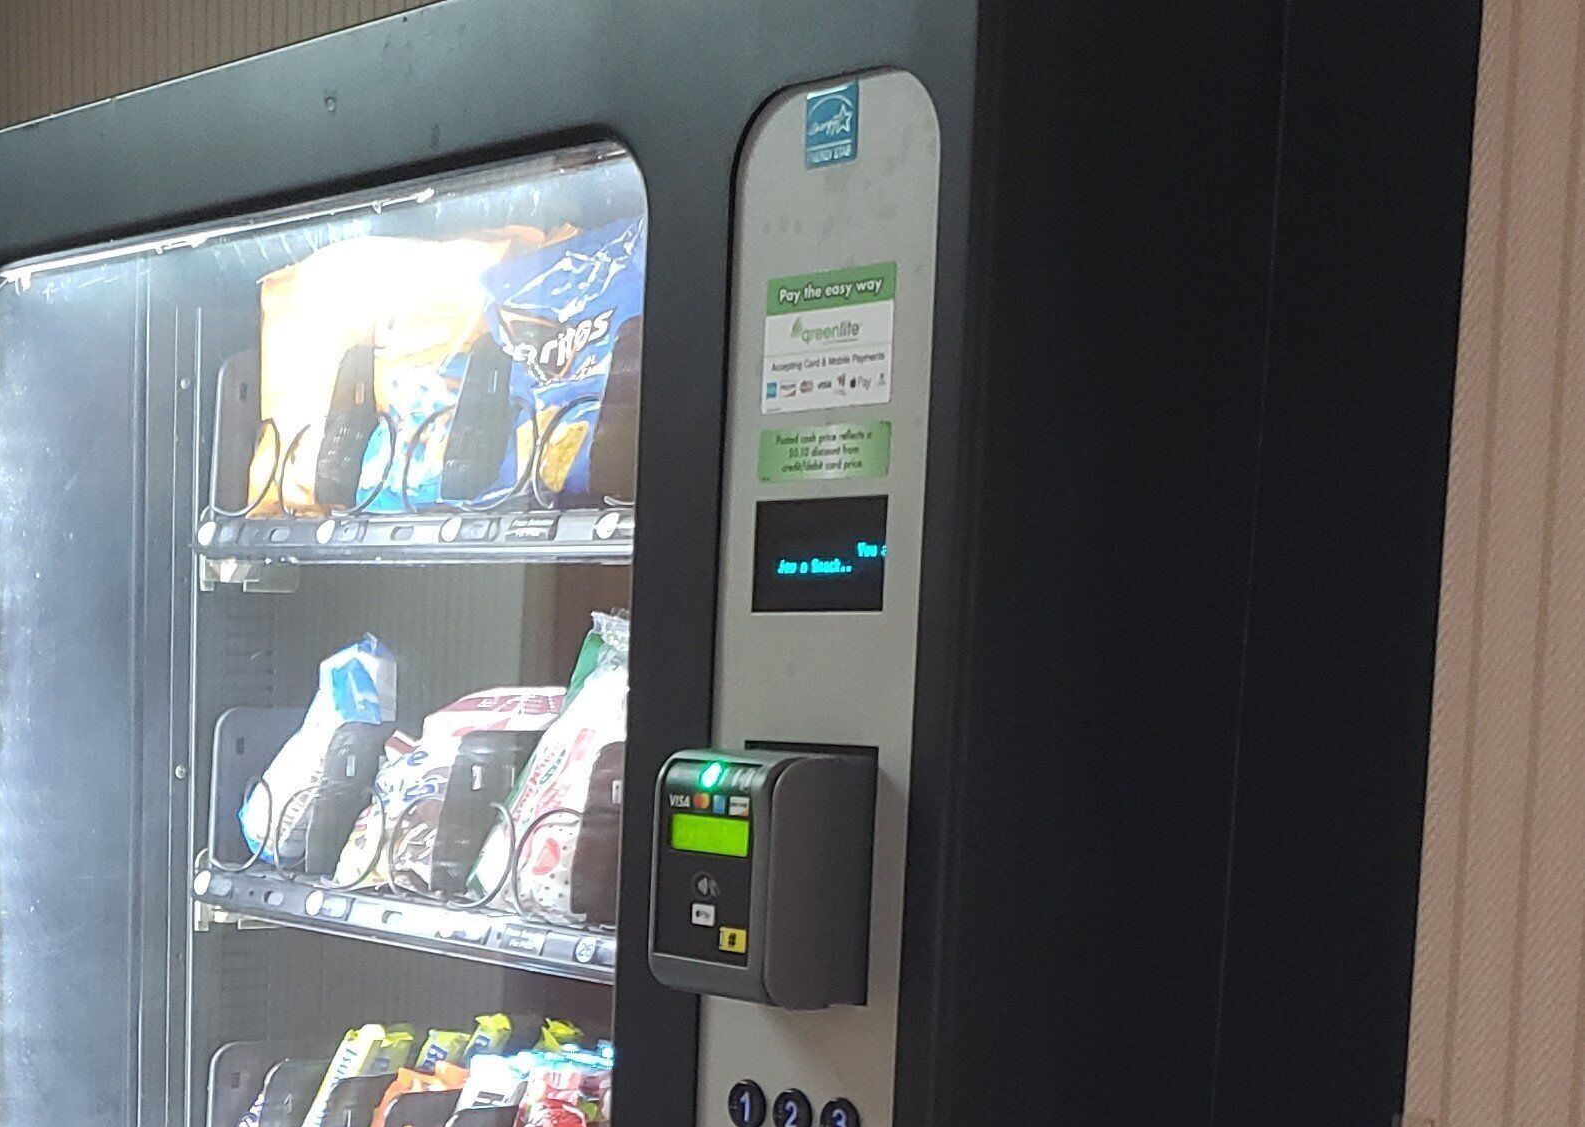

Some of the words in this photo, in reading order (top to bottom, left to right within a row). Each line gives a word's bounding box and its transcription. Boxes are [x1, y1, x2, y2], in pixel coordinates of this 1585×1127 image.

[779, 288, 801, 303] Pay
[803, 283, 822, 298] the
[825, 283, 852, 297] easy
[856, 278, 883, 293] way
[801, 320, 861, 344] greenlite
[668, 794, 691, 808] VISA
[739, 1091, 751, 1123] 1
